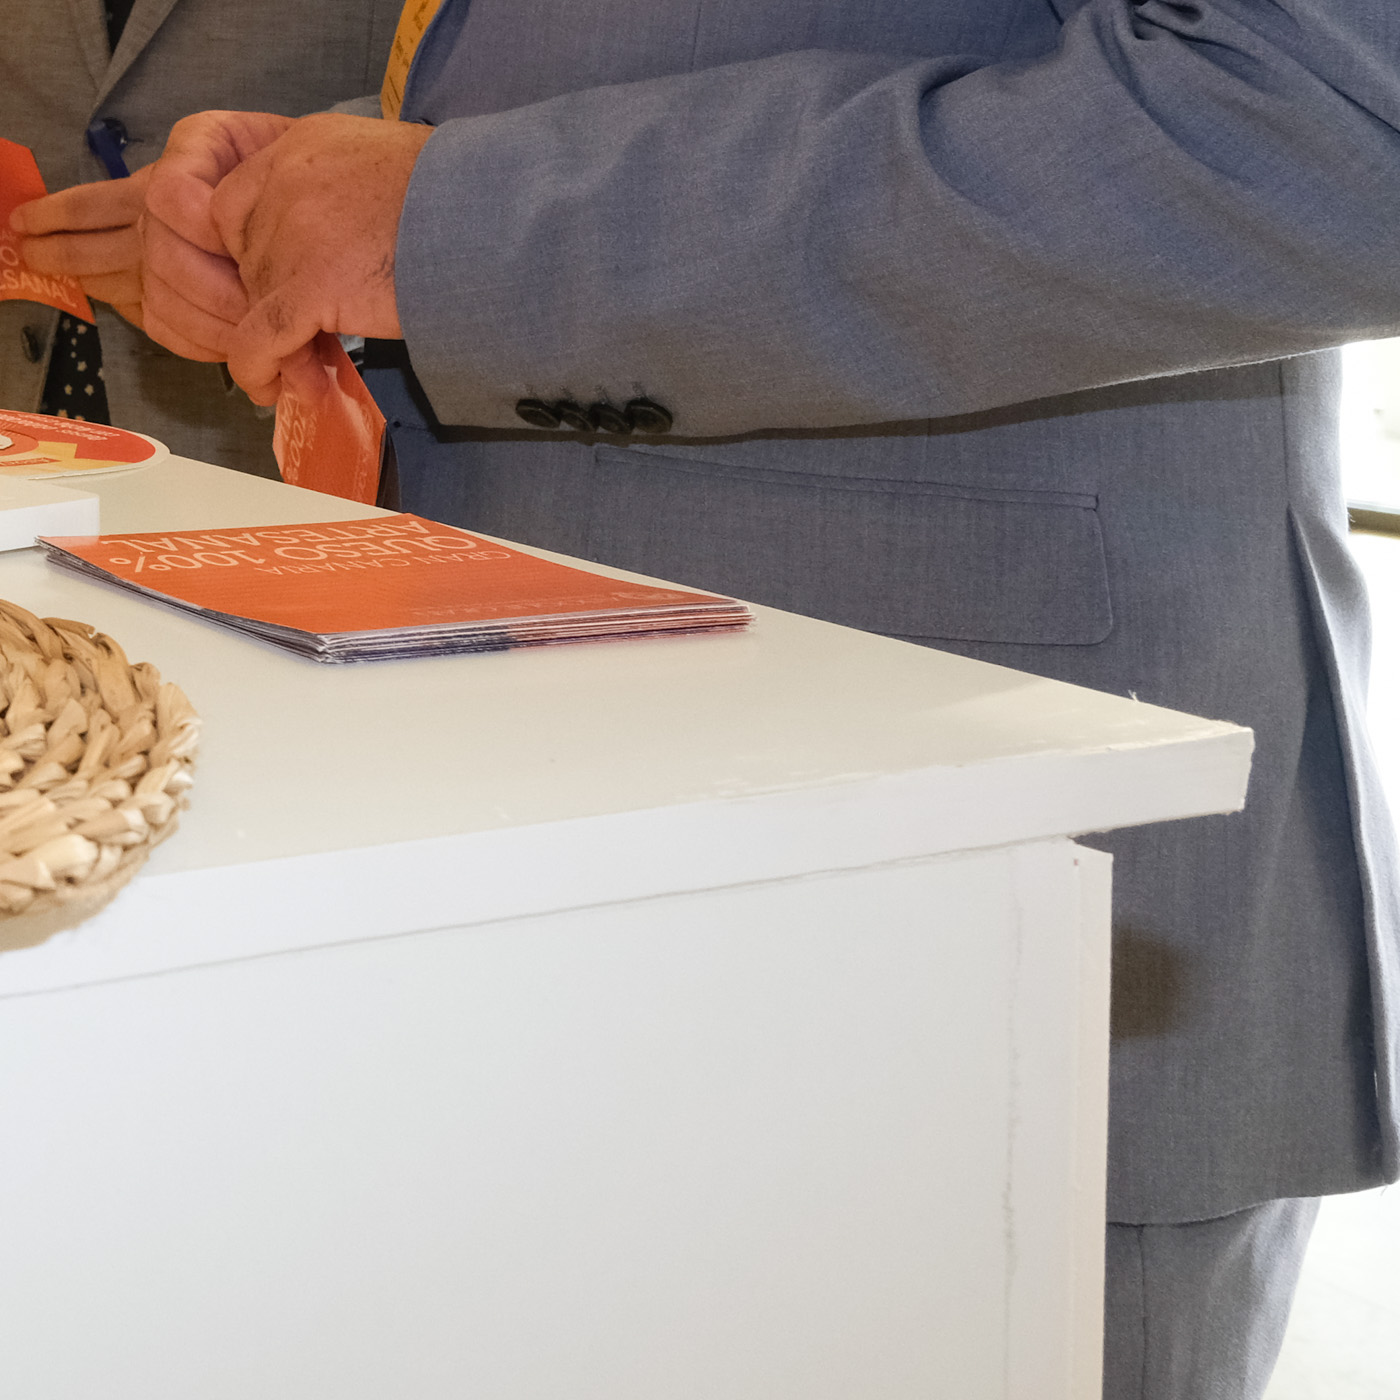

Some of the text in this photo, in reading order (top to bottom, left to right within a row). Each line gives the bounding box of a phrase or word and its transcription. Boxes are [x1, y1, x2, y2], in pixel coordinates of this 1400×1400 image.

[102, 520, 433, 554] ARTESANAL
[108, 535, 478, 574] QUESO 100%
[253, 548, 512, 576] GRAN CANARIA
